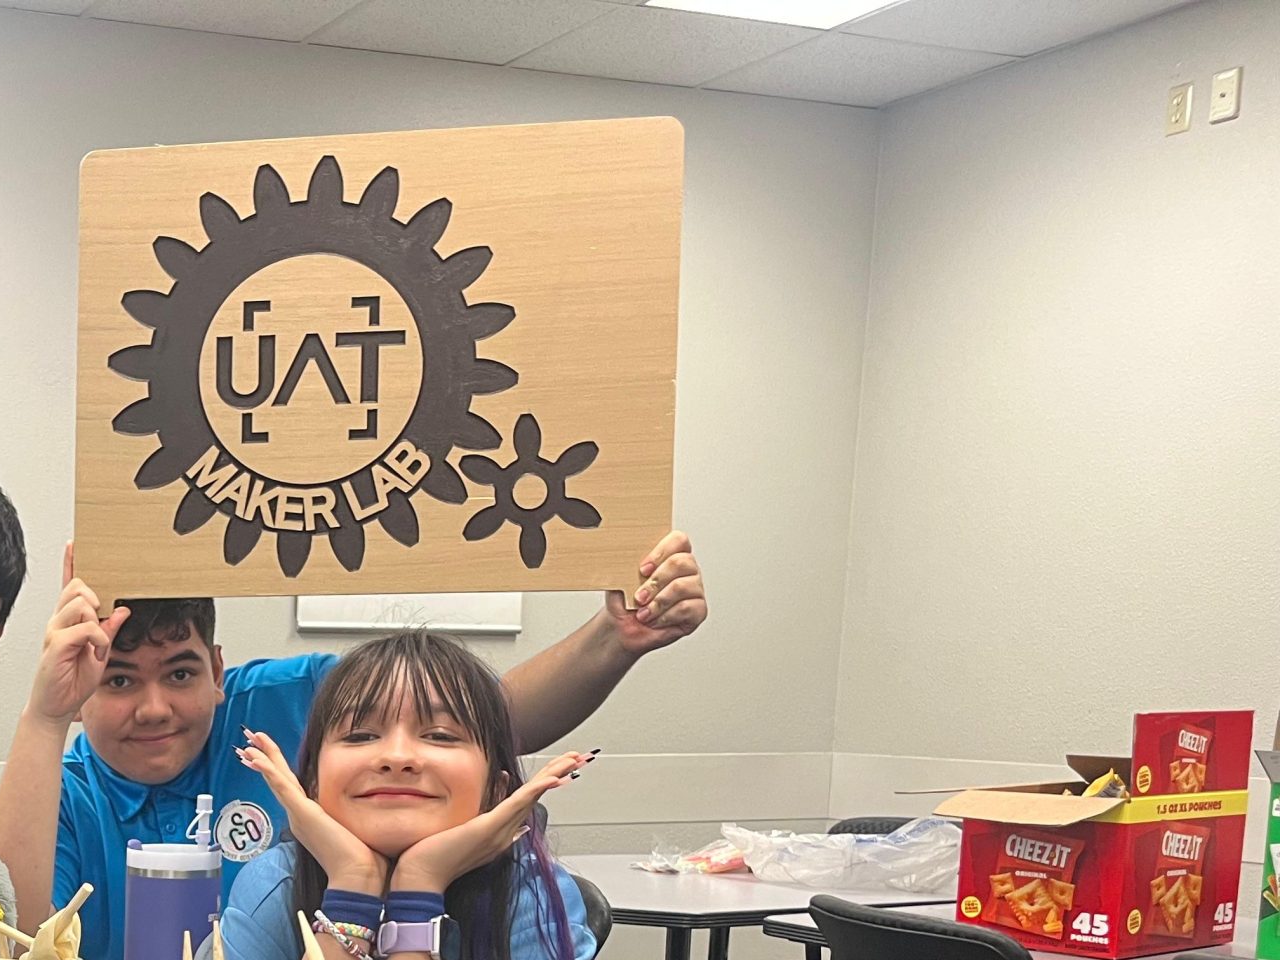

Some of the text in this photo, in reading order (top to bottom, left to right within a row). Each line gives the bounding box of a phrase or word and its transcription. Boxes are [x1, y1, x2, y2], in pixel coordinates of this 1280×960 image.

[185, 439, 432, 532] MAKER LAB
[1157, 804, 1167, 815] 1.5
[1179, 802, 1187, 812] XL
[1188, 800, 1222, 812] POUCHES
[1072, 912, 1109, 936] 45
[1214, 902, 1233, 924] 45
[1070, 933, 1109, 945] POUCHES
